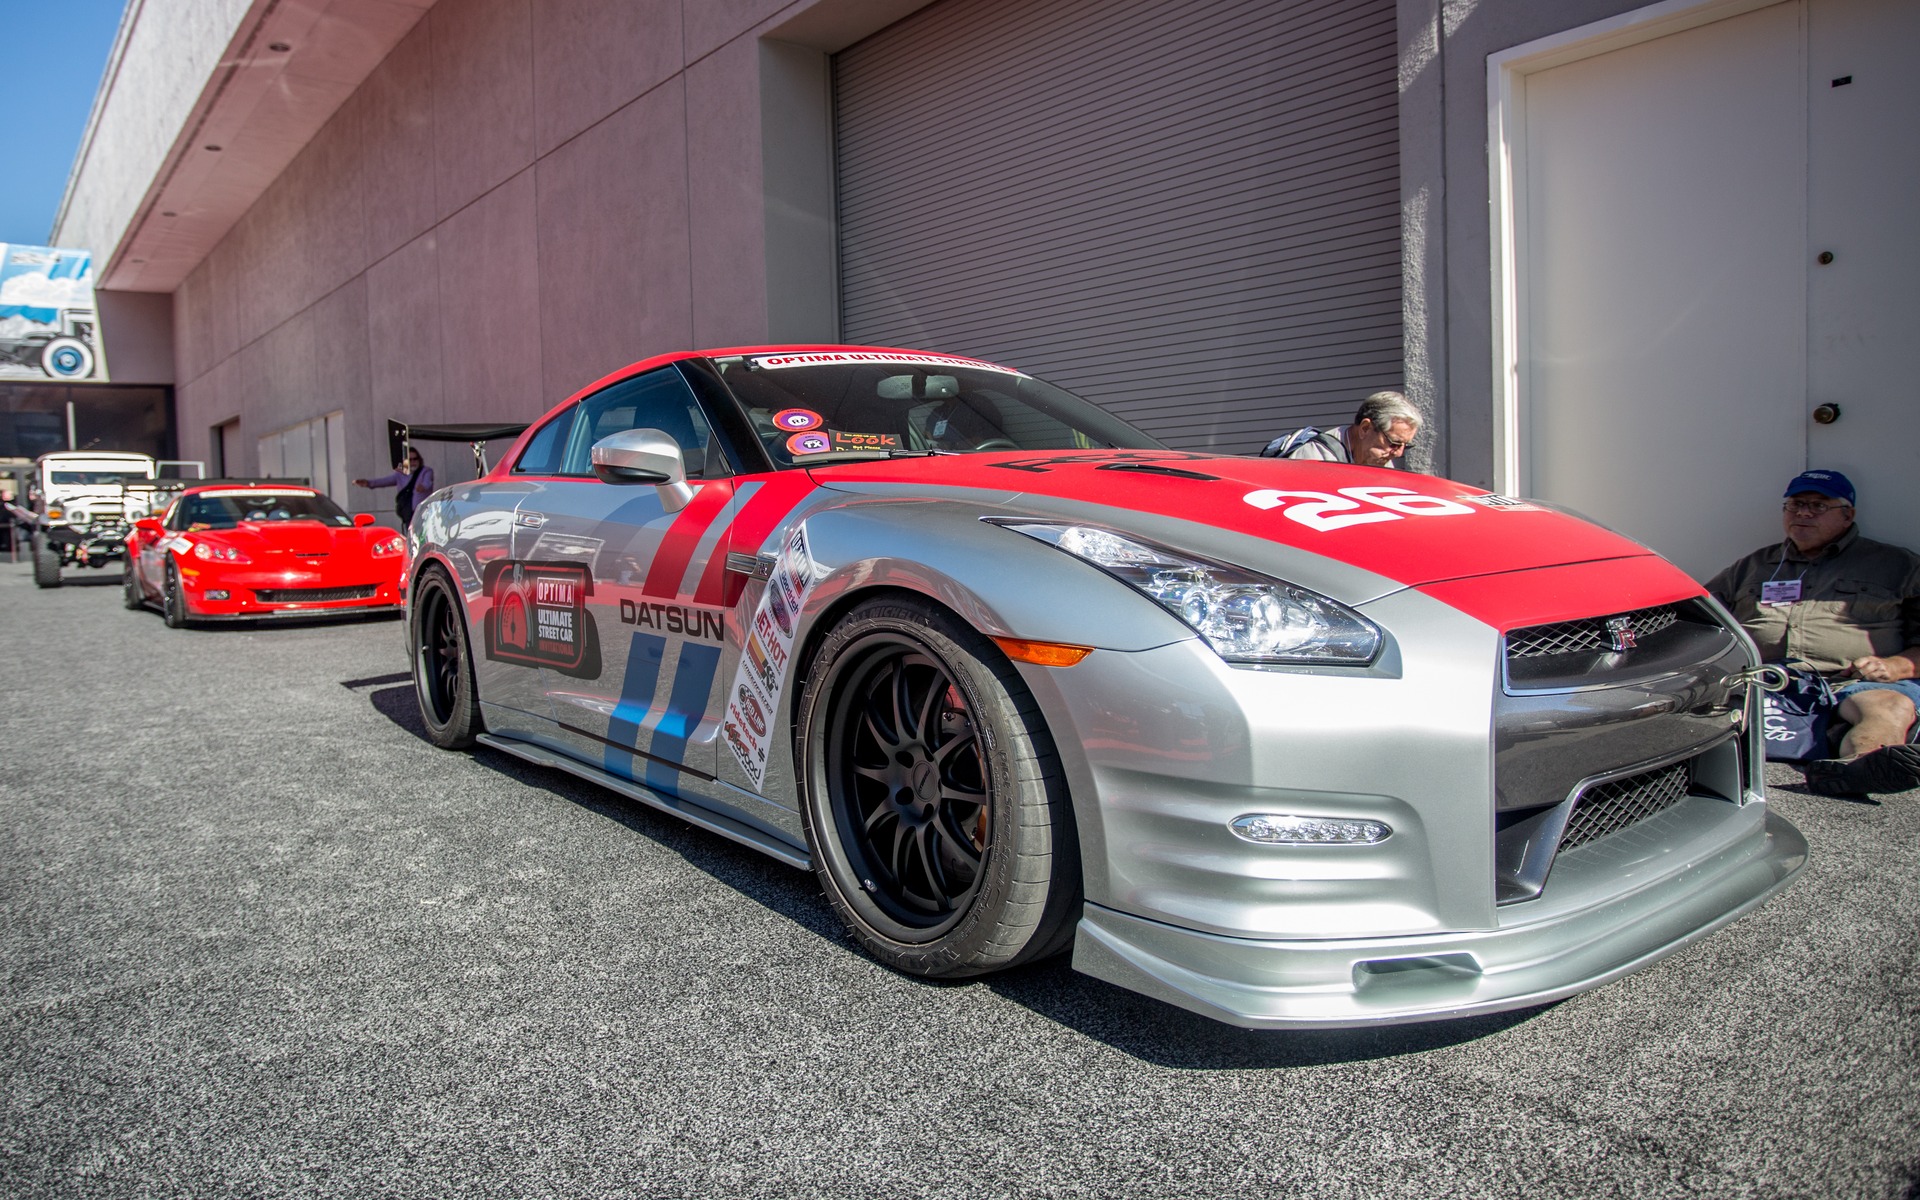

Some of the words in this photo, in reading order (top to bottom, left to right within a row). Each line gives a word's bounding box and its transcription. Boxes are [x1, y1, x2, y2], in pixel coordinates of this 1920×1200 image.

[767, 354, 847, 365] OPTIMA
[849, 354, 936, 363] ULTIMATE
[835, 432, 895, 445] Look
[1243, 486, 1476, 532] 26
[792, 533, 809, 585] OPTIMA
[538, 582, 572, 603] OPTIMA
[538, 609, 573, 628] ULTIMATE
[538, 625, 559, 640] STREET
[560, 628, 573, 642] CAR
[620, 598, 724, 641] DATSUN
[757, 608, 787, 669] JET-HOT
[730, 702, 758, 751] ridetech
[746, 699, 755, 715] RED
[754, 712, 765, 732] LINE
